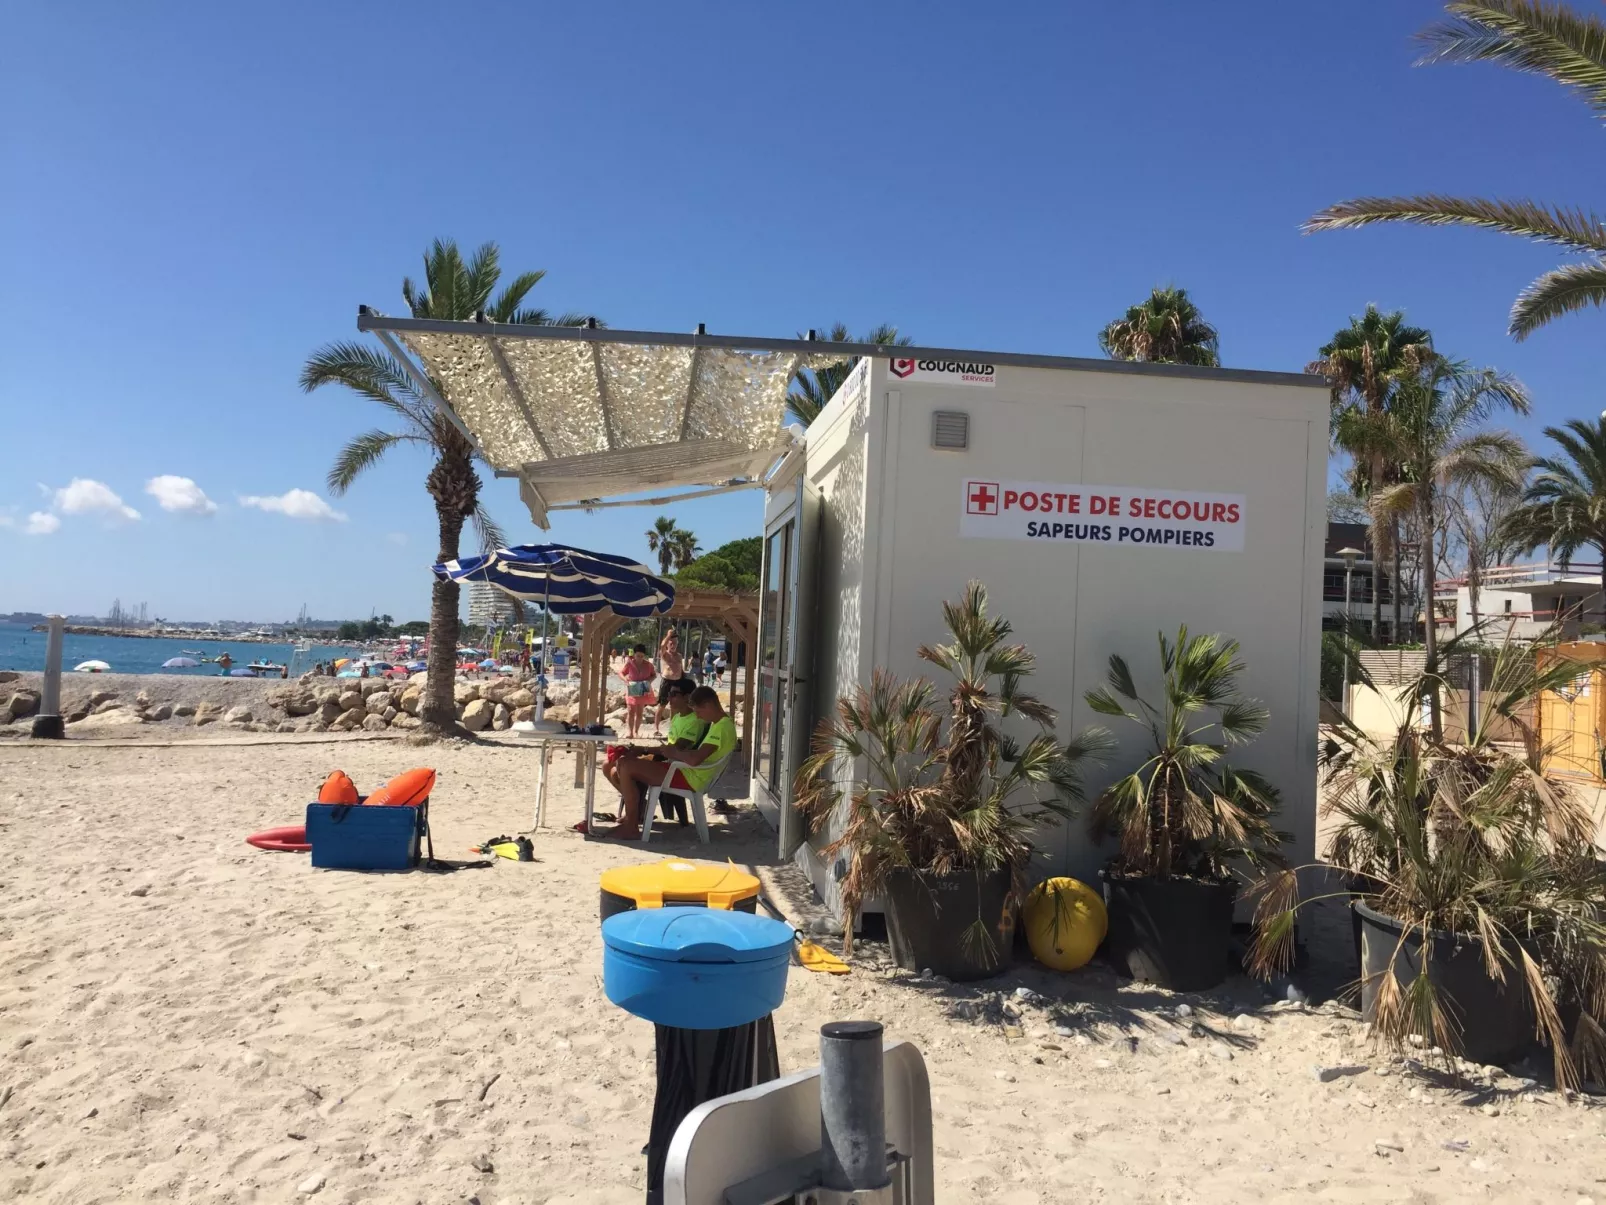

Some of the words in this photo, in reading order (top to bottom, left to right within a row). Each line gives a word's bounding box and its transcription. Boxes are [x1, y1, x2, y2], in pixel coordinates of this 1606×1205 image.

[918, 360, 995, 375] COUGNAUD
[1003, 490, 1081, 514] POSTE
[1089, 495, 1121, 516] DE
[1128, 497, 1240, 523] SECOURS
[1026, 521, 1112, 541] SAPEURS
[1118, 526, 1215, 547] POMPIERS
